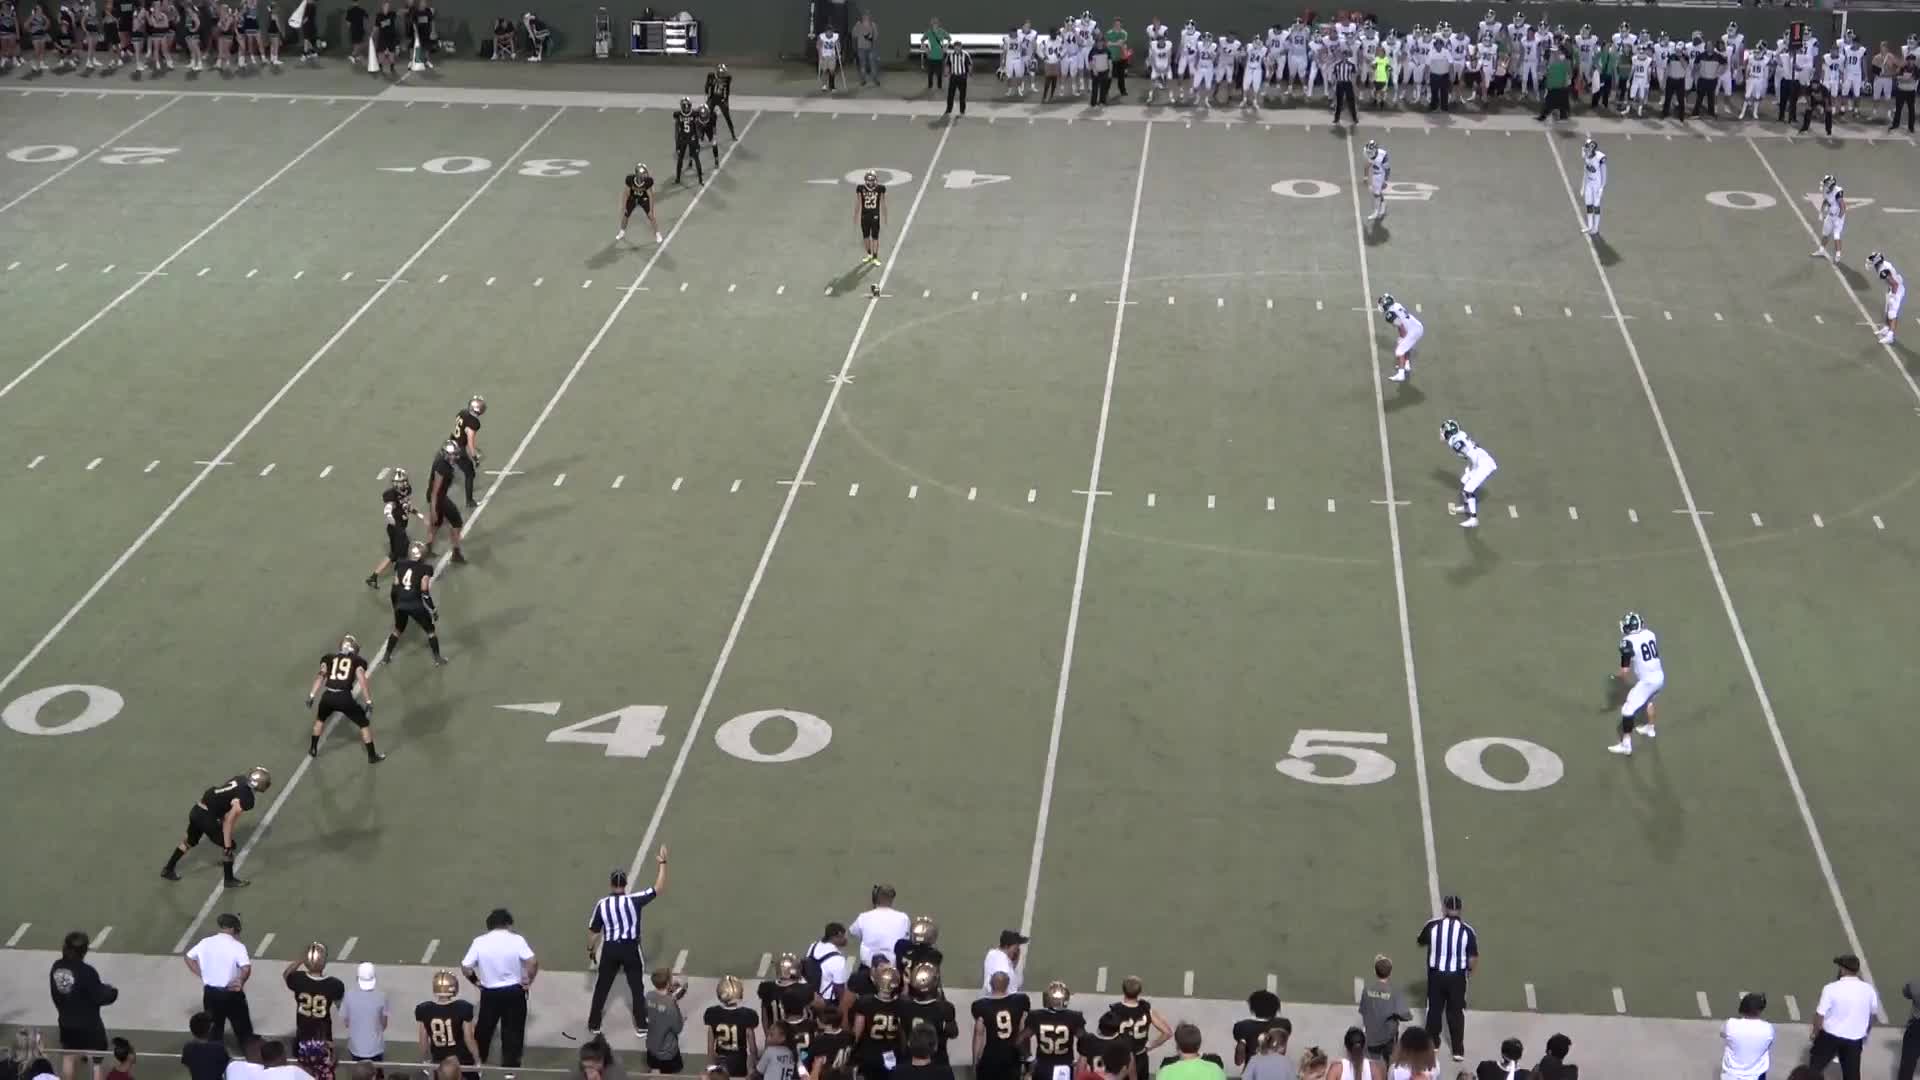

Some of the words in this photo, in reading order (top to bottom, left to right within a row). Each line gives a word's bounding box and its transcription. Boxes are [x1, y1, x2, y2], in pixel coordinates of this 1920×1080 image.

[683, 120, 691, 133] 5
[863, 195, 878, 209] 23
[402, 567, 414, 591] 4
[1640, 639, 1659, 662] 80
[329, 656, 352, 681] 19
[298, 992, 328, 1019] 28
[430, 1017, 457, 1048] 81
[715, 1023, 739, 1051] 21
[995, 1009, 1014, 1040] 9
[1038, 1023, 1071, 1055] 52
